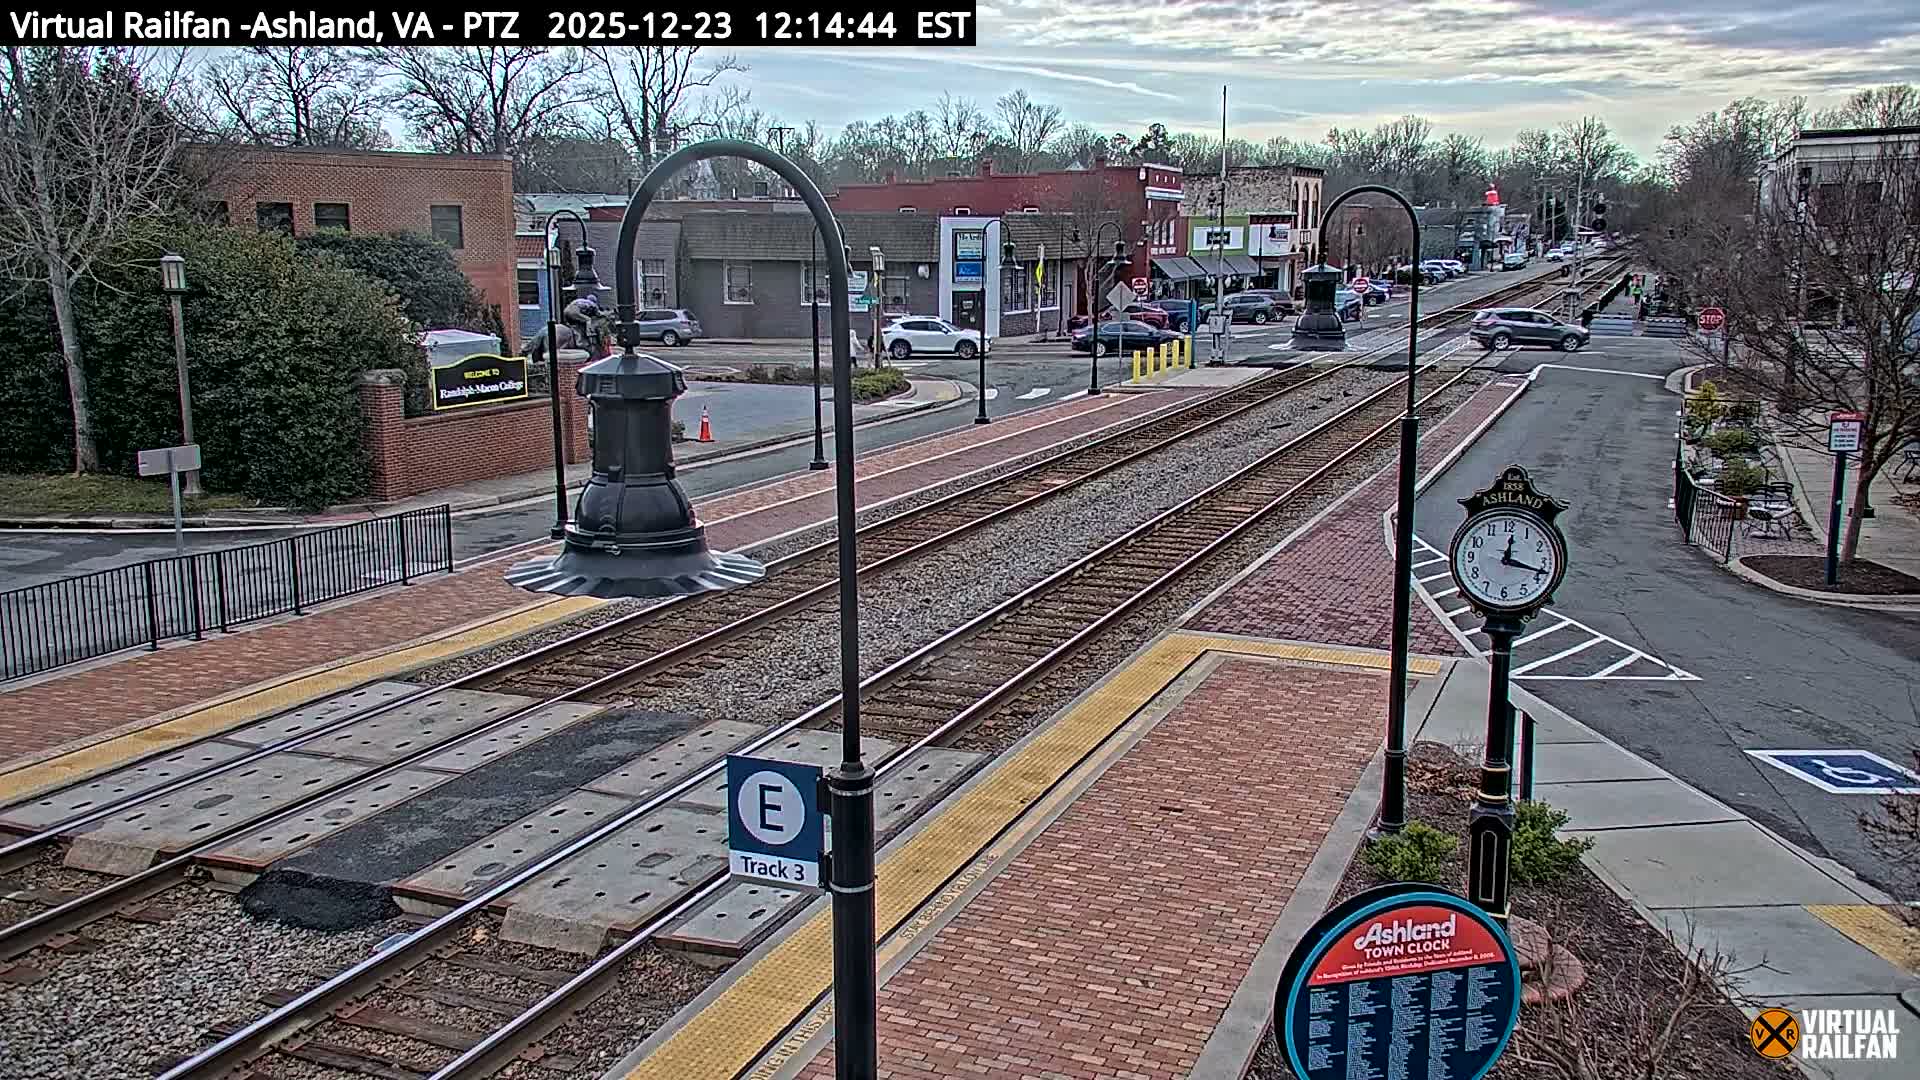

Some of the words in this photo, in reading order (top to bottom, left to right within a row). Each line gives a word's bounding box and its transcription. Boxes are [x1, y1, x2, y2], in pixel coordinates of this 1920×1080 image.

[1699, 314, 1722, 325] STOP
[464, 370, 491, 379] WELCOME
[1482, 492, 1544, 509] ASHLAND
[1487, 523, 1496, 537] 11
[1504, 520, 1515, 533] 12
[1524, 527, 1529, 539] 1
[1472, 536, 1484, 548] 10
[1536, 540, 1544, 553] 2
[1467, 551, 1475, 563] 9
[1471, 567, 1479, 579] 8
[1482, 581, 1490, 593] 7
[1500, 587, 1508, 598] 6
[1519, 584, 1528, 596] 5
[759, 784, 784, 832] E
[740, 855, 788, 879] Track
[794, 863, 805, 881] 3
[1354, 913, 1456, 950] Ashland
[1364, 943, 1404, 959] TOWN
[1407, 939, 1450, 954] CLOCK
